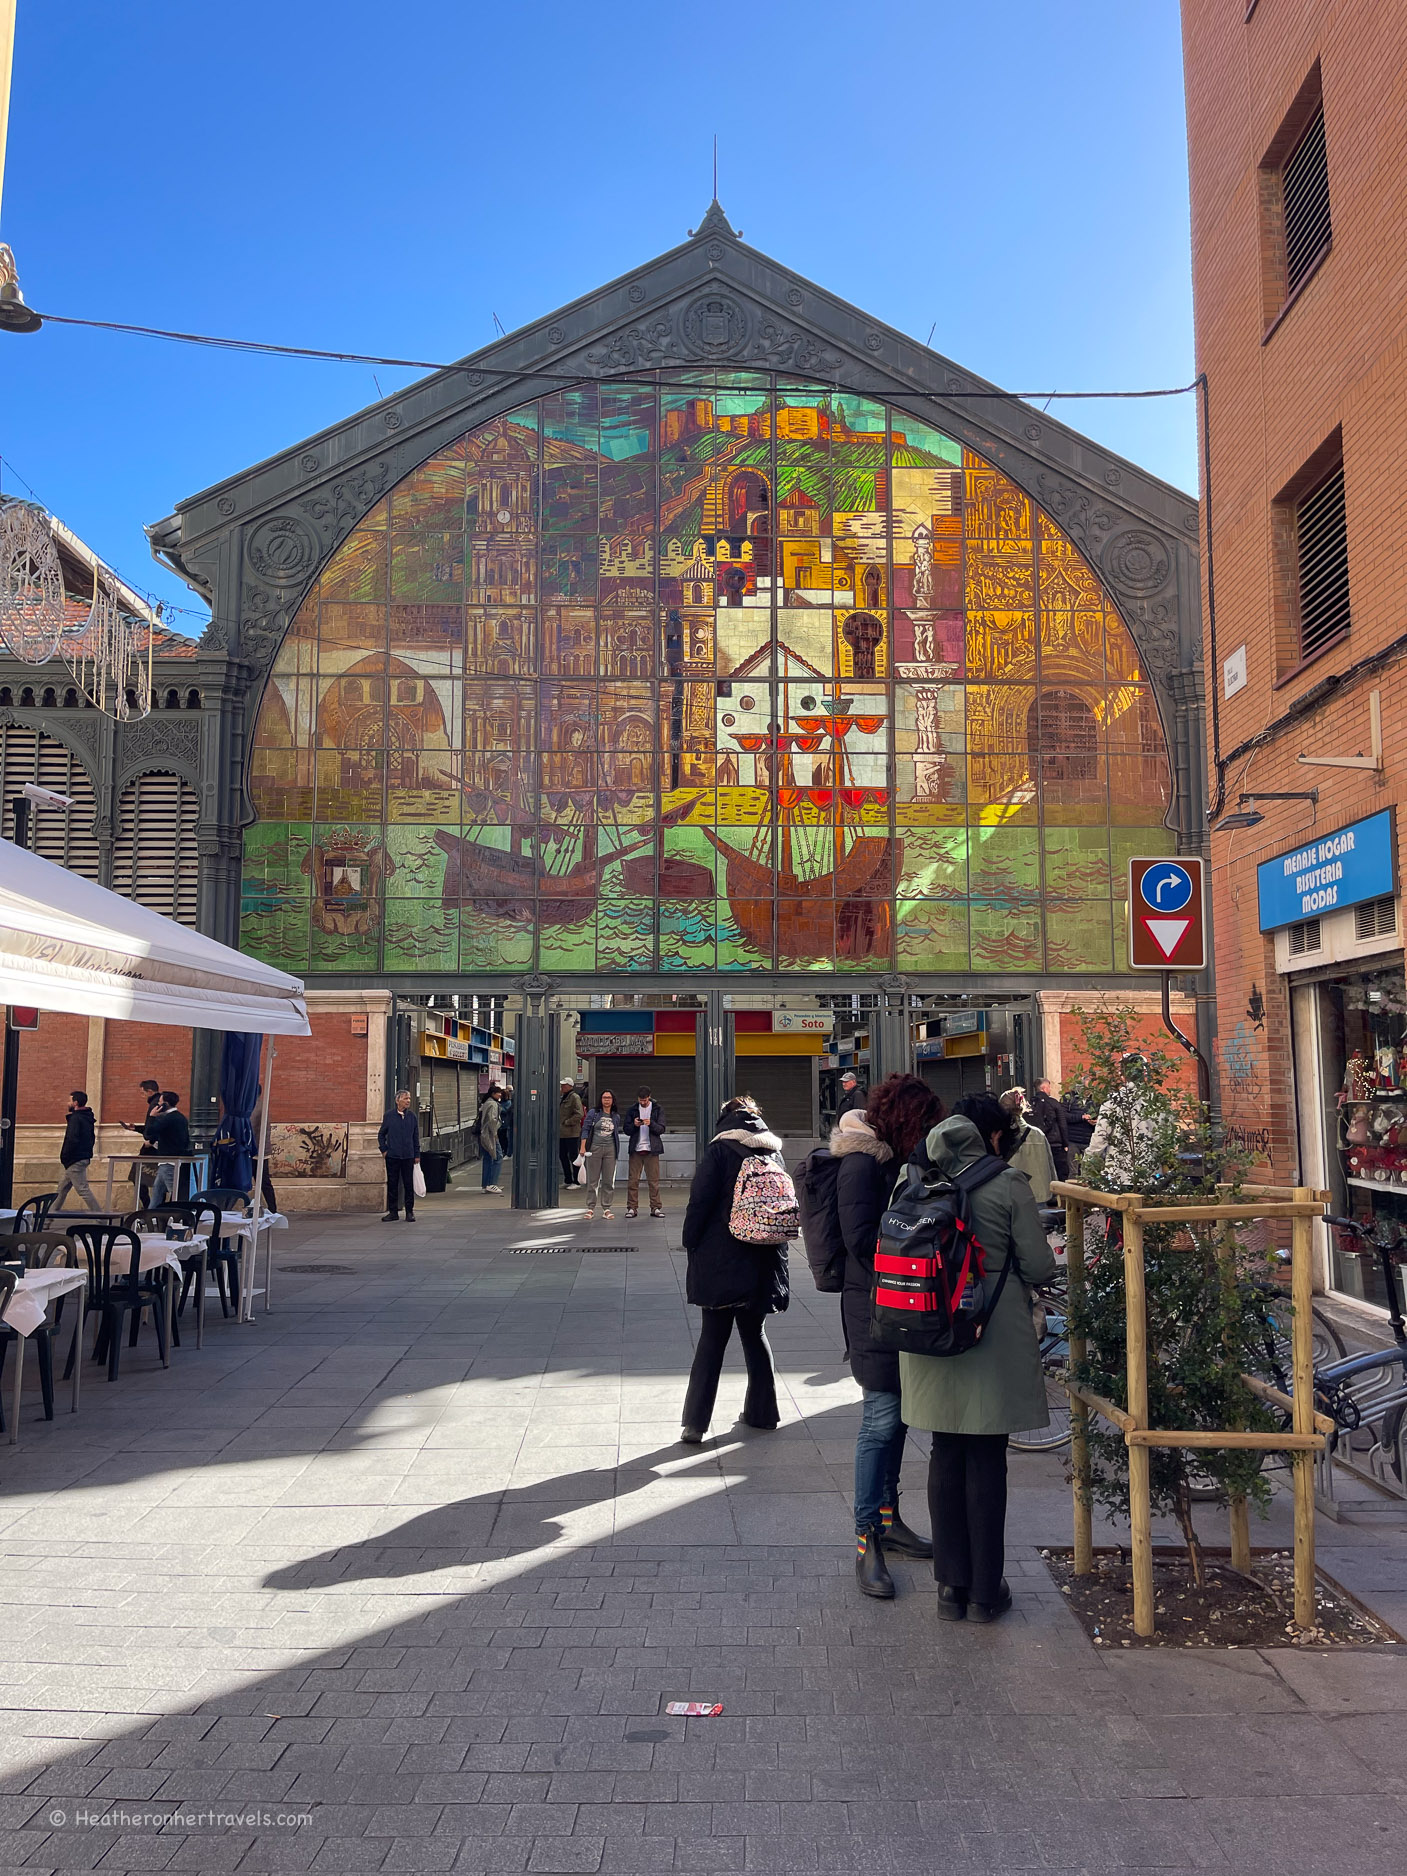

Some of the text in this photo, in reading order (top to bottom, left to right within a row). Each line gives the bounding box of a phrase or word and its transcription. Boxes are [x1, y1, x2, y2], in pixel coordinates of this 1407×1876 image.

[1284, 832, 1355, 876] MENAJE HOGAR
[1296, 861, 1342, 894] BISUTERIA
[1302, 885, 1337, 913] MODAS
[801, 1019, 824, 1028] Soto
